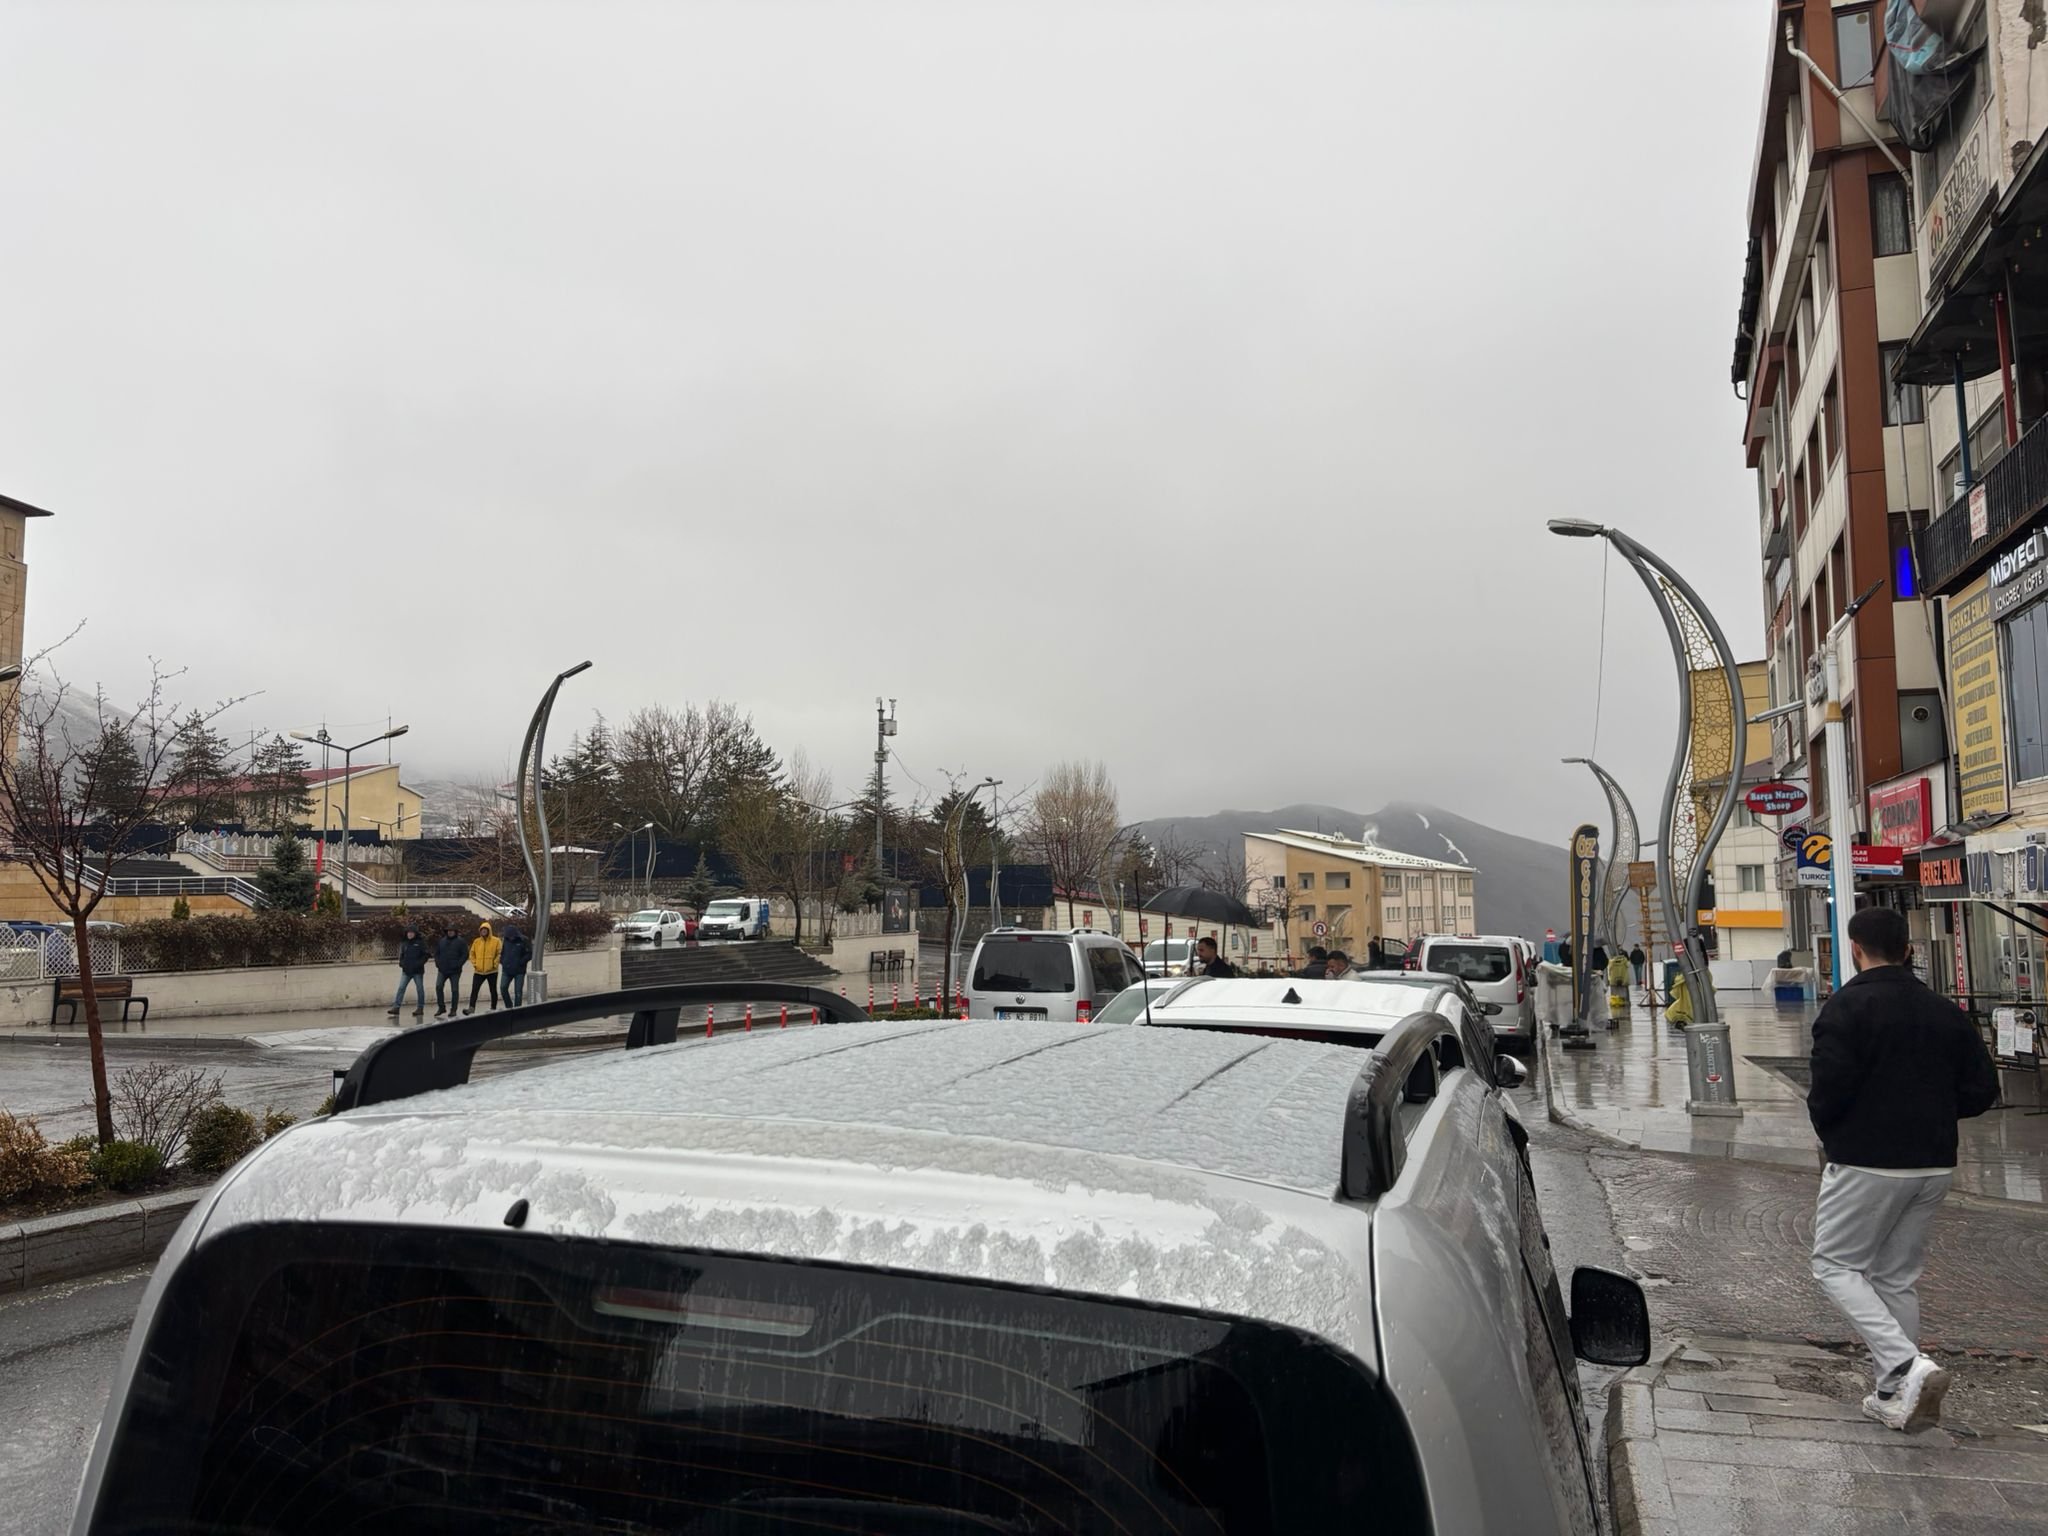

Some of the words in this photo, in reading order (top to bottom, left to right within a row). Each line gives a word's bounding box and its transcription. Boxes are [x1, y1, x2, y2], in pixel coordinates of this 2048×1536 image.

[1991, 528, 2038, 588] MİDYECİ
[2024, 569, 2043, 594] KÖFTE
[1750, 792, 1773, 802] Barça
[1775, 790, 1804, 800] Nargile
[1800, 873, 1830, 881] TURKCE
